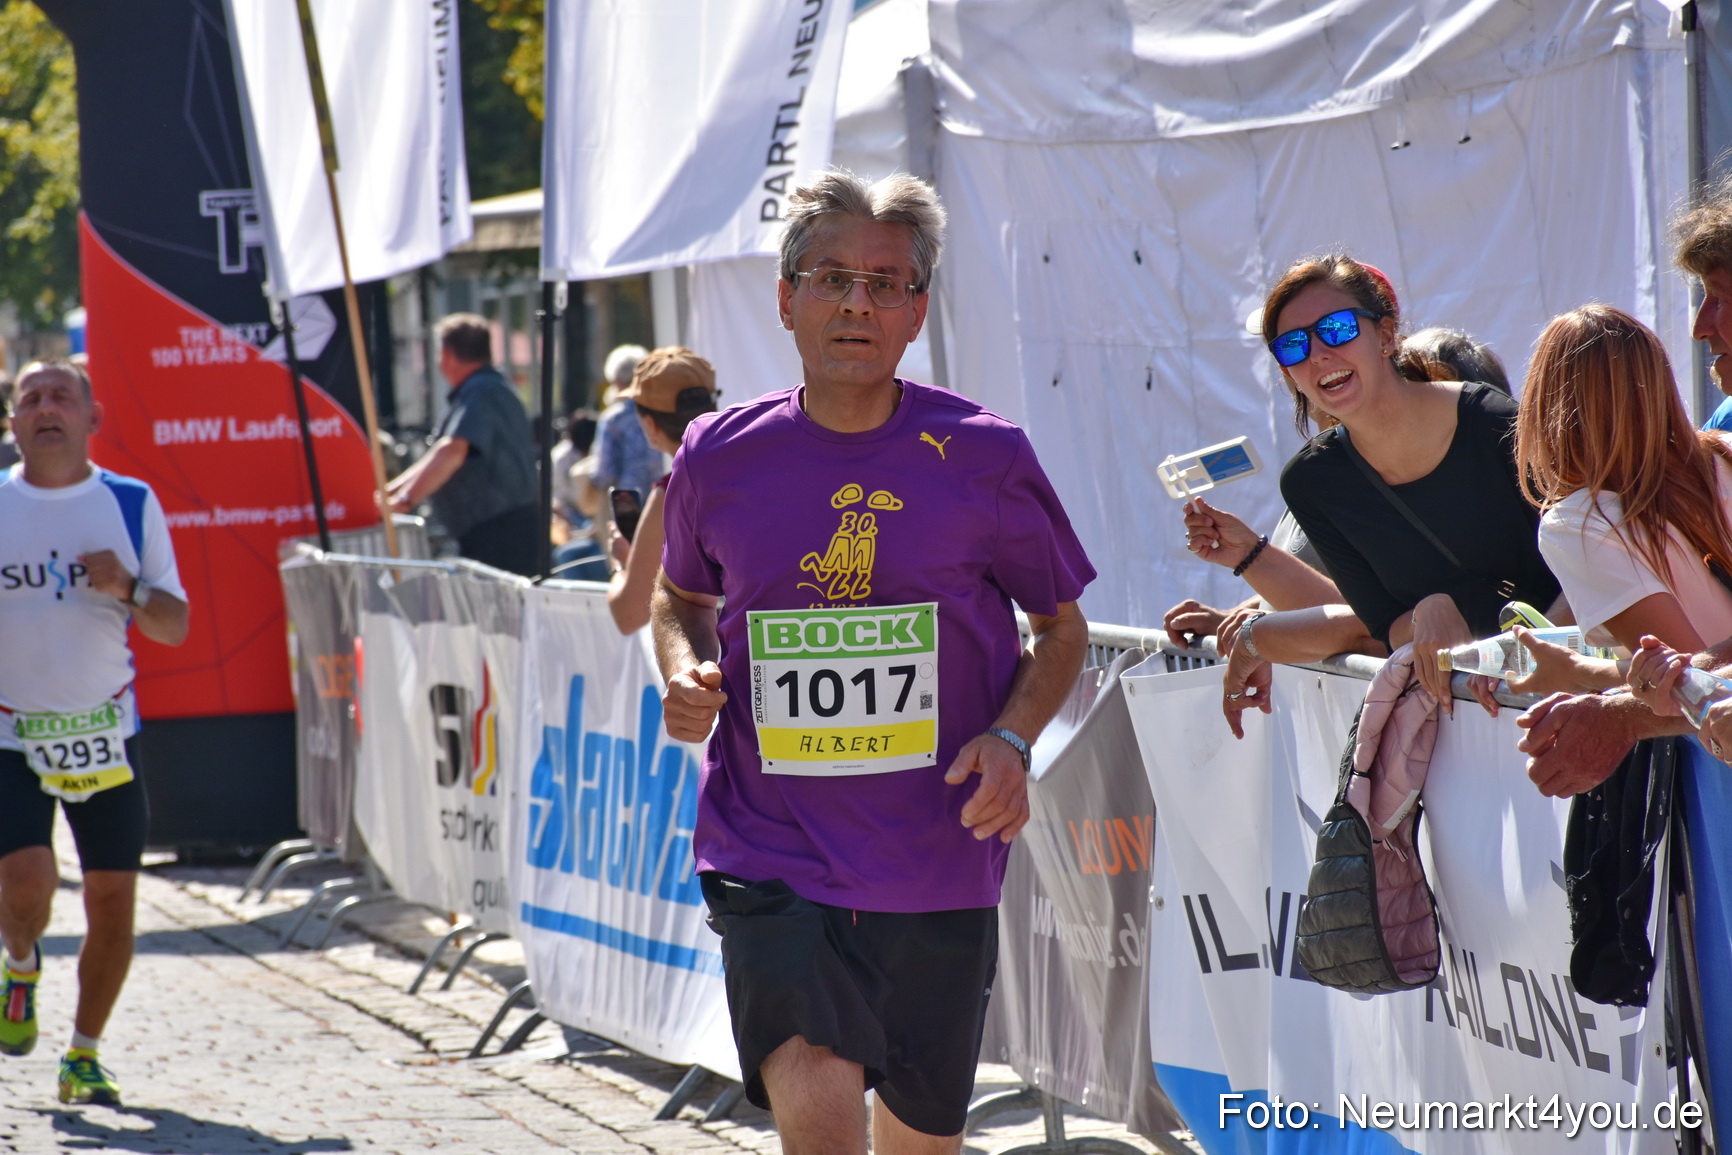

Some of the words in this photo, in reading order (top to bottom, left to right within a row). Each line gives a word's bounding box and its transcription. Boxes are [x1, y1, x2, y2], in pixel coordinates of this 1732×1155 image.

[761, 86, 806, 224] PARTL
[179, 327, 216, 346] THE
[151, 347, 182, 367] 100
[185, 344, 248, 366] YEARS
[154, 417, 221, 445] BMW
[227, 414, 343, 442] Laufsort
[763, 612, 923, 654] BOCK
[775, 664, 917, 718] 1017
[25, 710, 109, 736] BOCK
[35, 737, 111, 770] 1293
[799, 734, 896, 753] ALBERT
[62, 775, 99, 791] AKIN
[1067, 815, 1153, 876] LOUN
[1425, 943, 1611, 1074] RAIL.ONE
